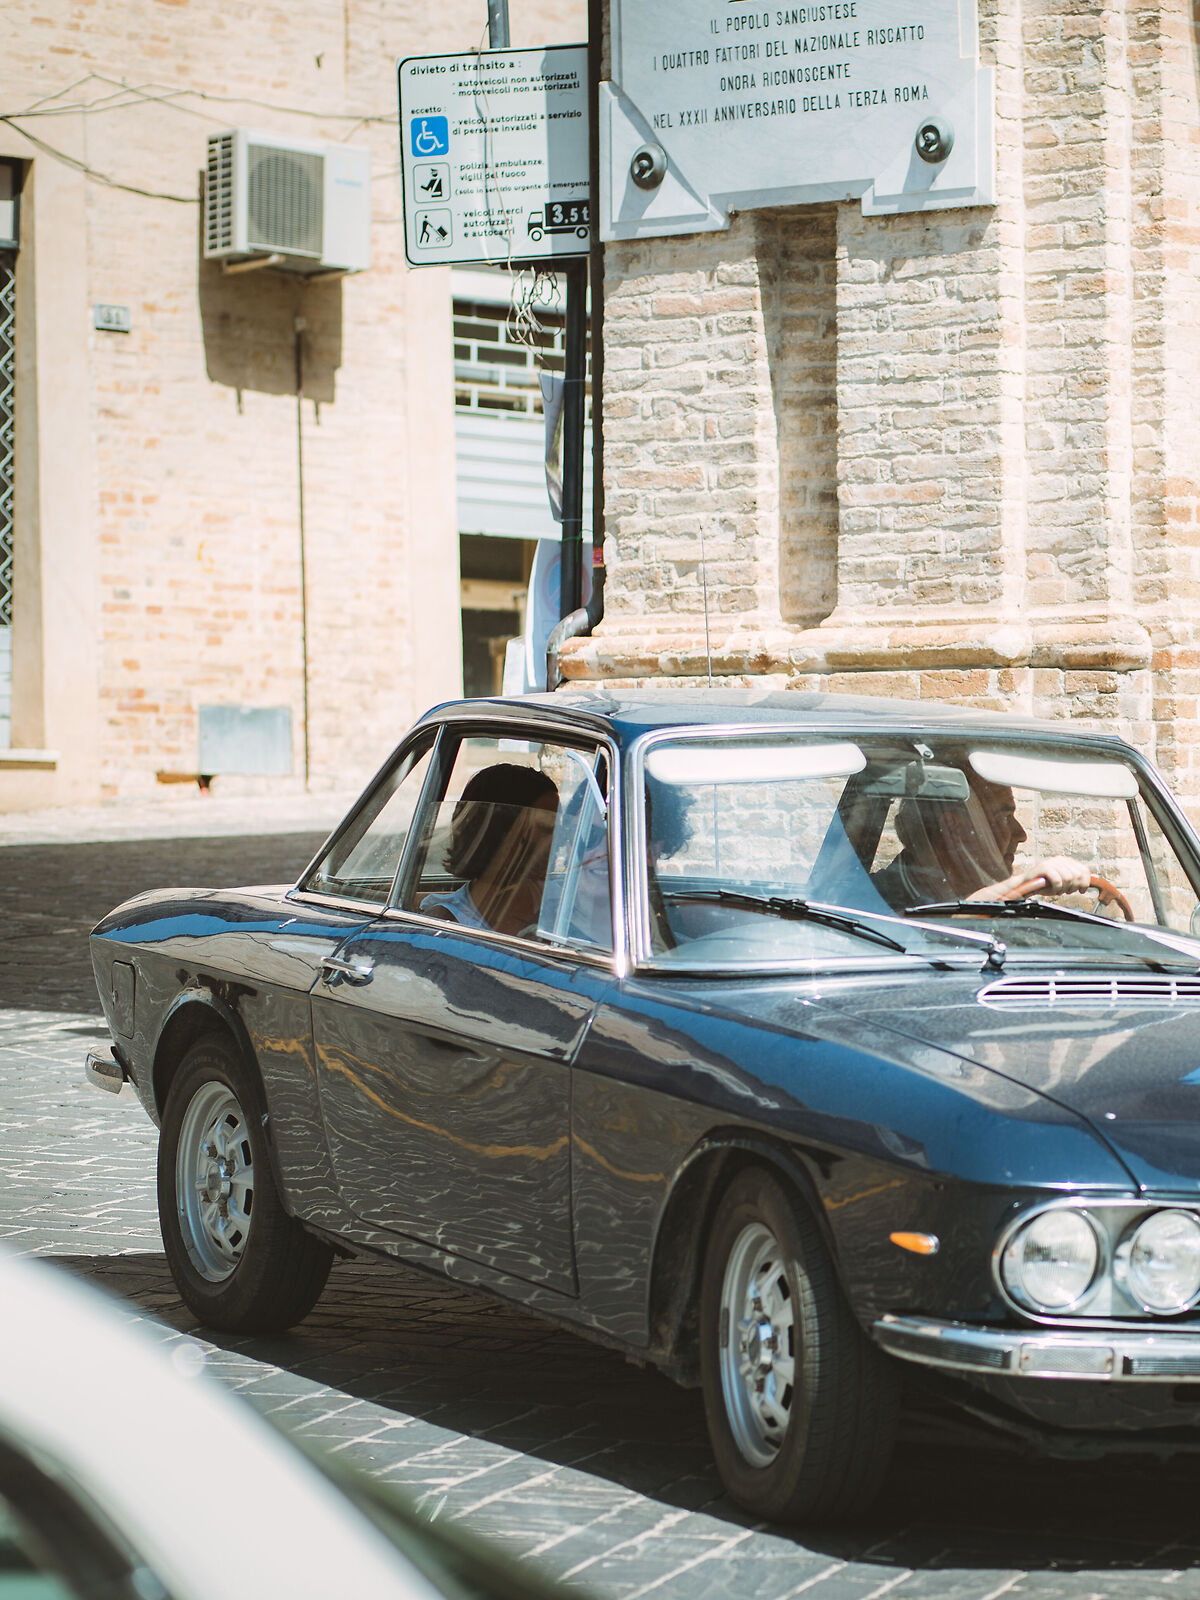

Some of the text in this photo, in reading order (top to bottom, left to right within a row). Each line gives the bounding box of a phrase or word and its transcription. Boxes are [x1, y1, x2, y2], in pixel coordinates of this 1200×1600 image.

[710, 2, 857, 34] IL POPOLO SANGIUSTESE
[653, 25, 924, 71] I QUATTRO FATTORI DEL NAZIONALE RISCATTO
[410, 65, 446, 75] divieto
[449, 63, 459, 72] di
[463, 60, 505, 71] transito
[458, 77, 508, 87] autoveicoli
[530, 71, 577, 82] autorizzati
[720, 63, 850, 91] ONORA RICONOSCENTE
[458, 86, 510, 96] motoveicoli
[533, 81, 580, 91] autorizzati
[653, 84, 928, 129] NEL XXXII ANNIVERSARIO DELLA TERZA ROMA
[458, 117, 487, 125] veicoli
[490, 112, 537, 123] autorizzati
[548, 109, 582, 119] servizio
[452, 123, 537, 136] di persone invalide
[460, 170, 526, 181] vigili del fuoco
[464, 208, 494, 217] veicoli
